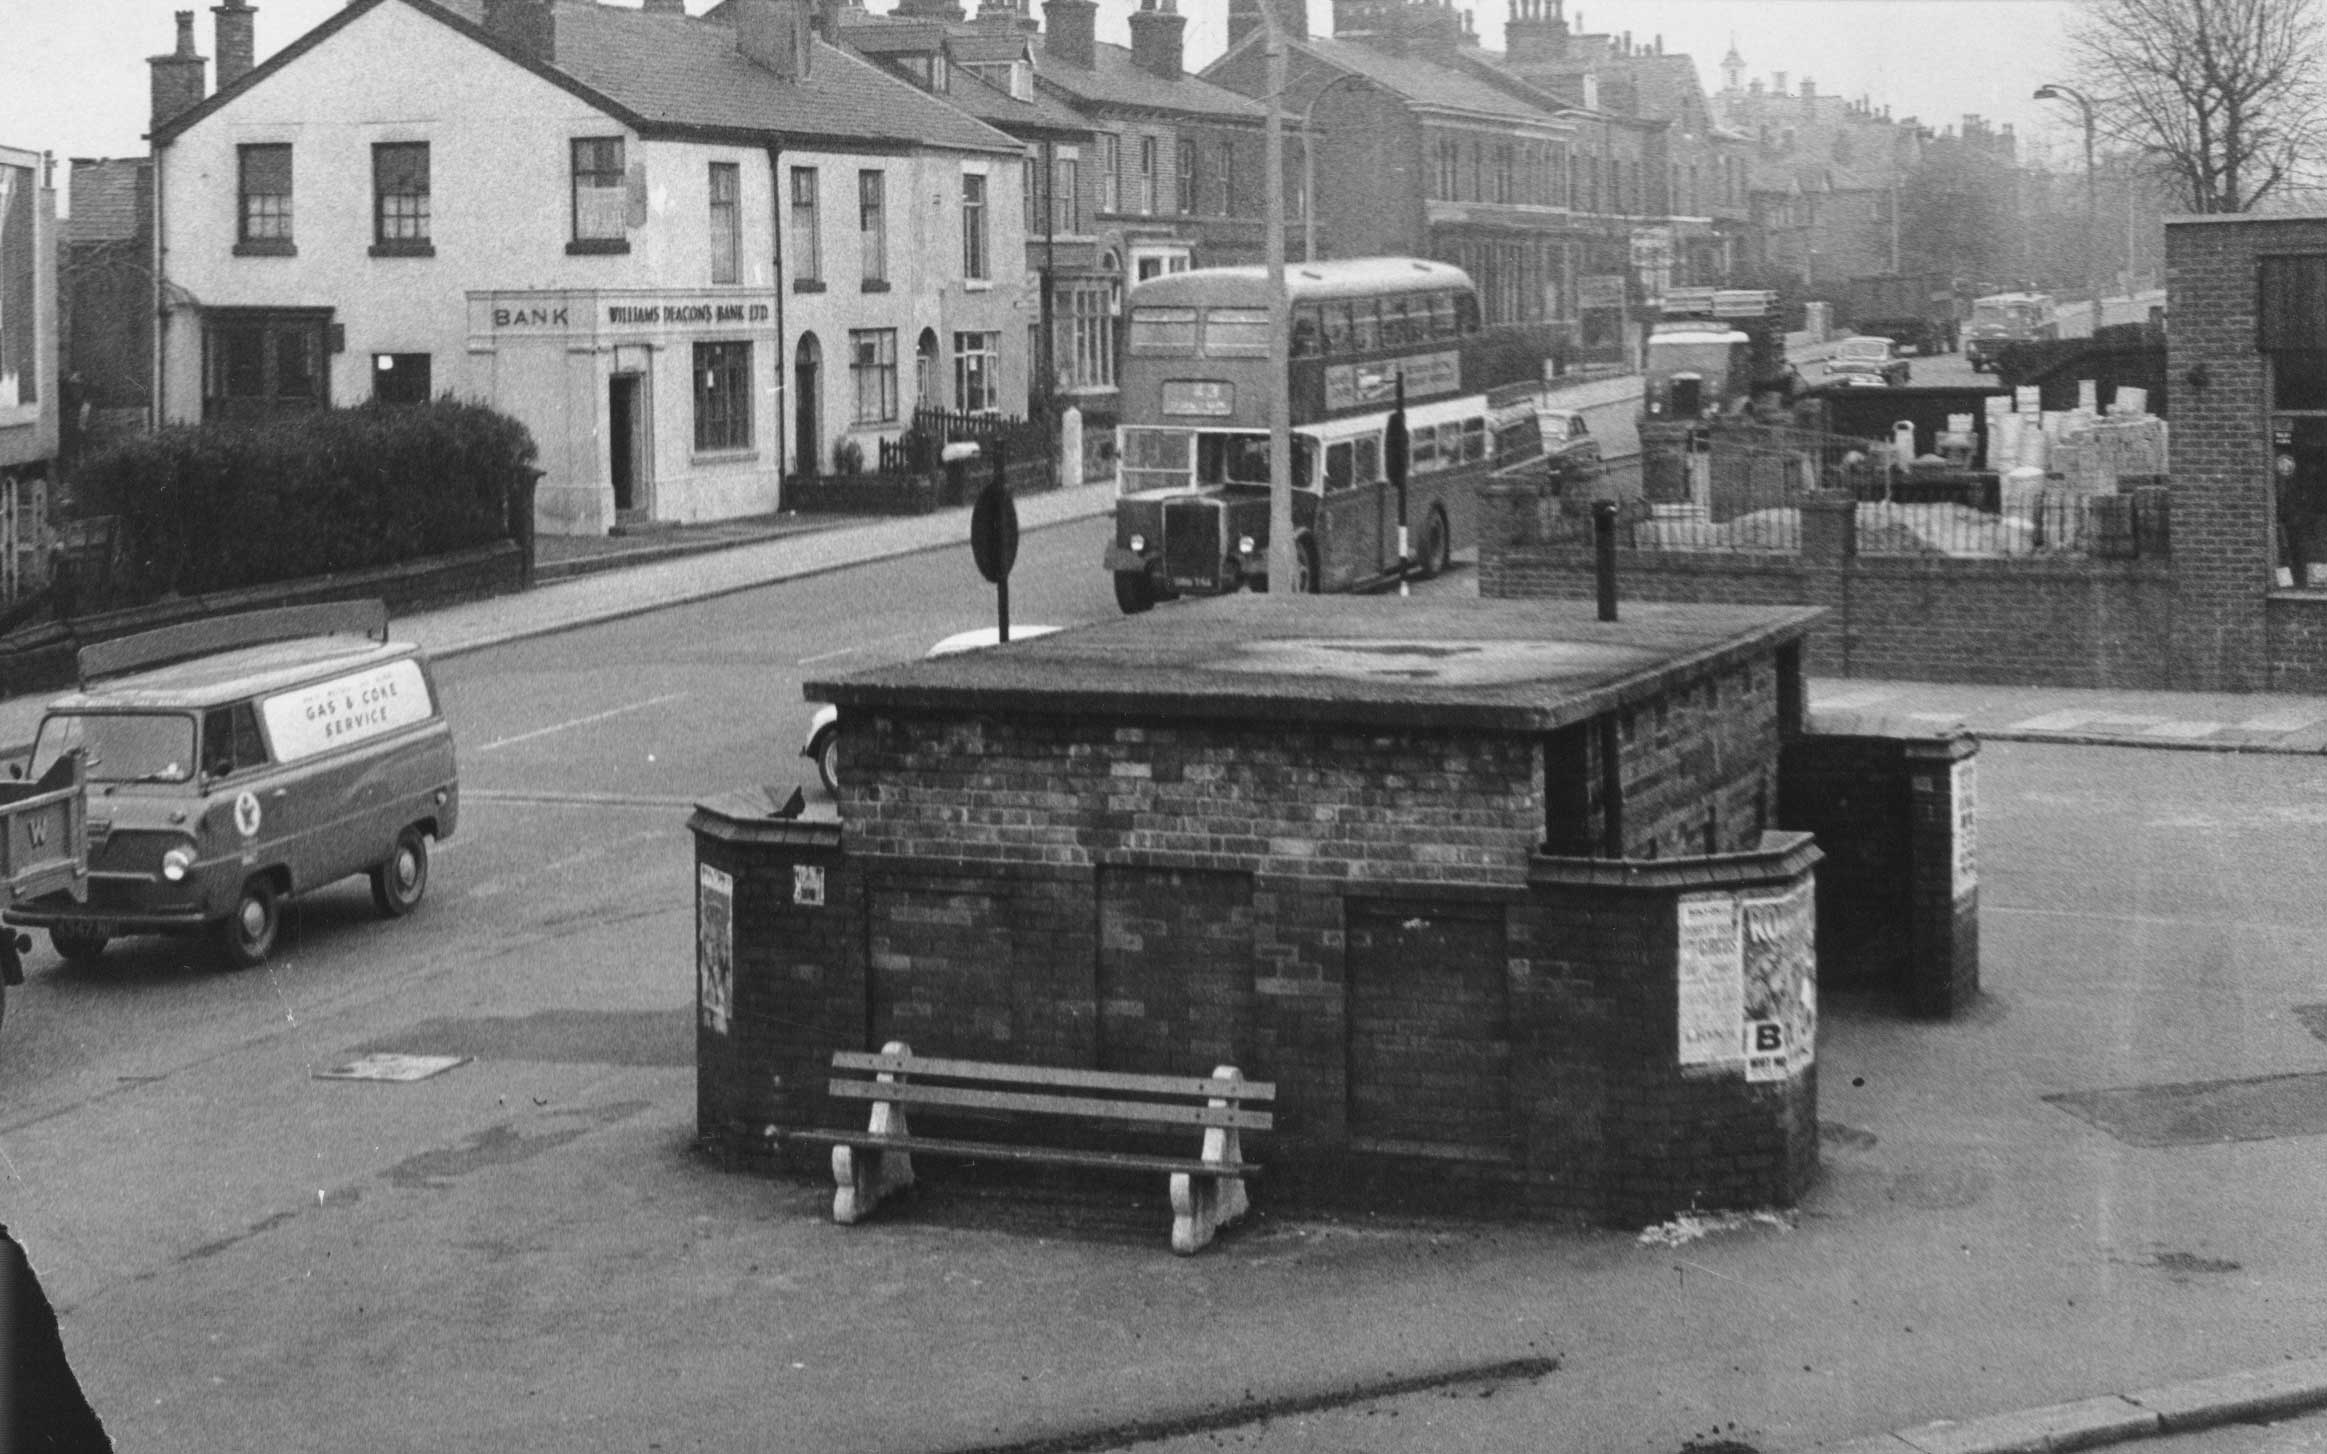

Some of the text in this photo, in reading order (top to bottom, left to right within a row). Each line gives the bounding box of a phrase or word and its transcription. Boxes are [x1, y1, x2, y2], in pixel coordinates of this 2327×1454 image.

[494, 308, 569, 327] BANK
[609, 305, 661, 323] WILLIAMS
[663, 303, 713, 323] DEACON'S
[716, 304, 745, 322] BANK
[306, 700, 337, 720] GAS
[345, 695, 354, 710] &
[361, 681, 398, 705] COKE
[325, 705, 388, 738] SERVICE
[1756, 1024, 1782, 1052] B
